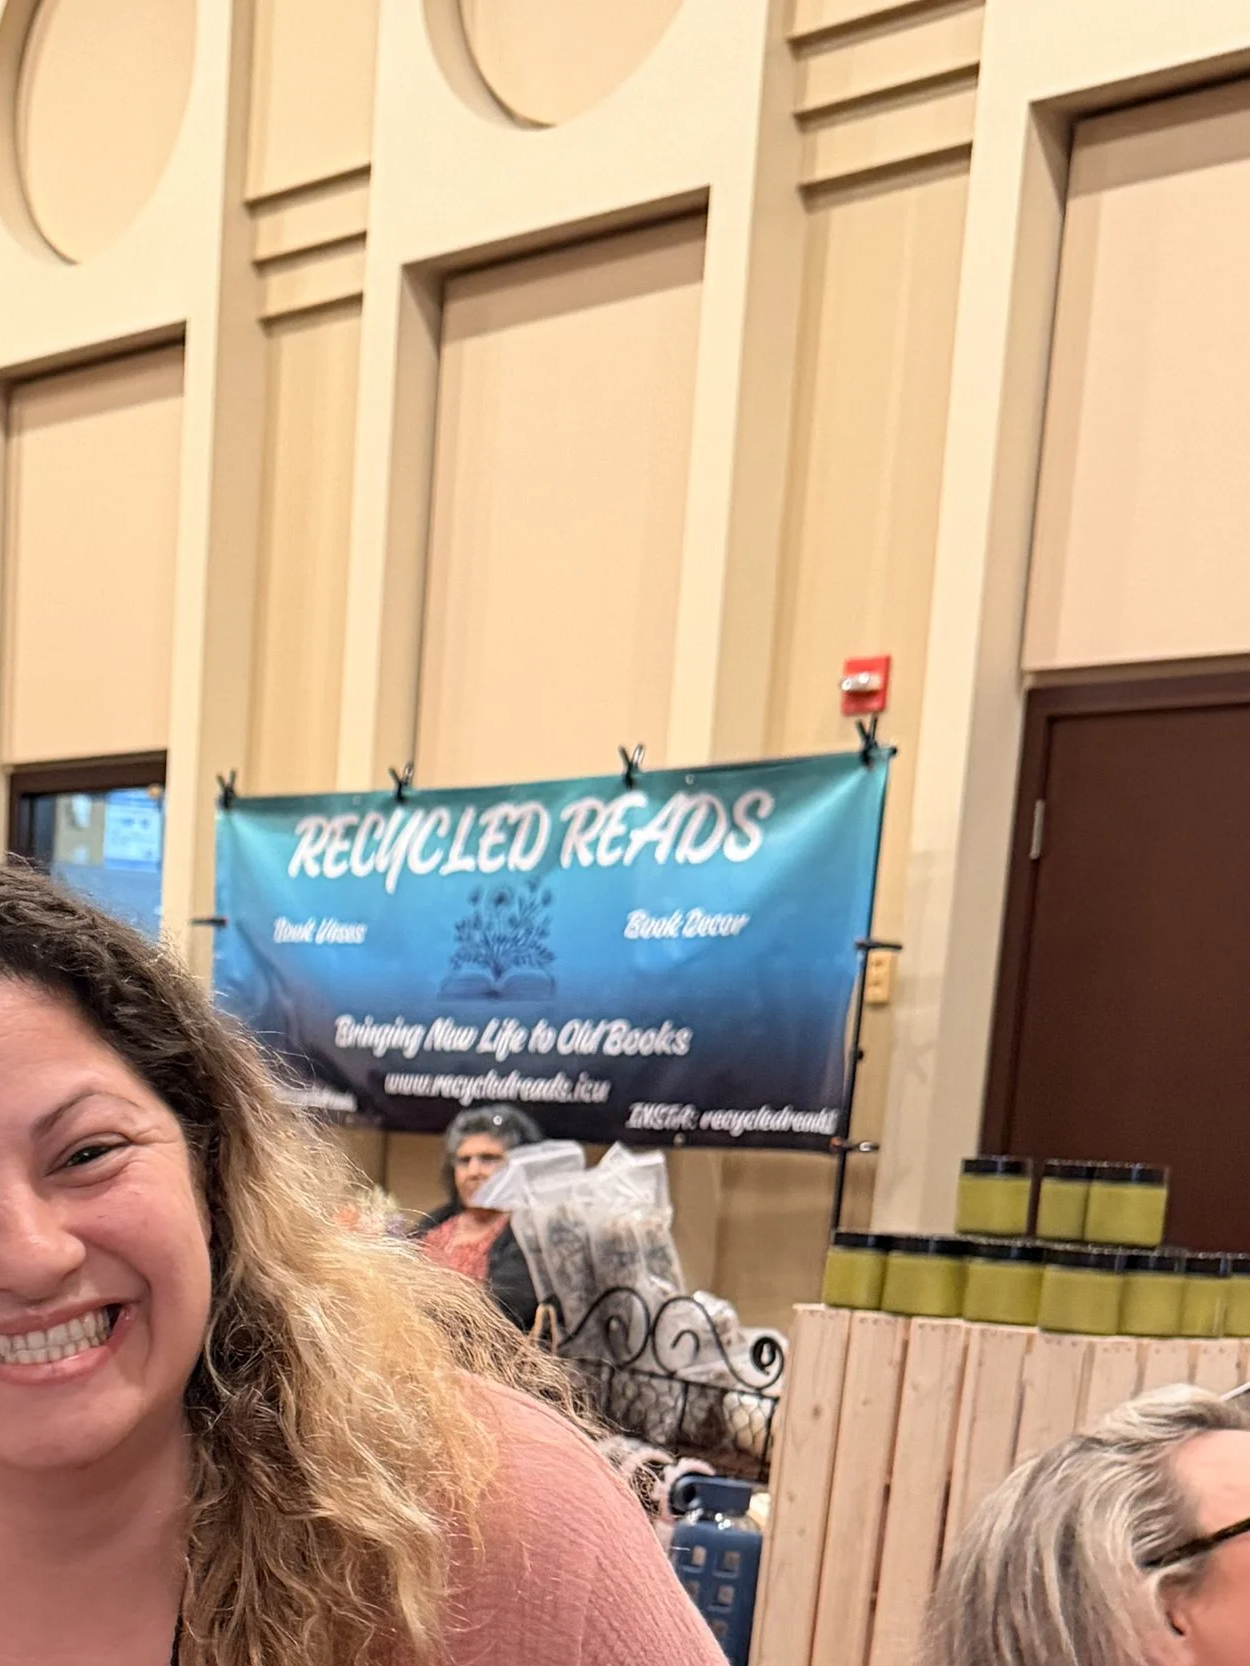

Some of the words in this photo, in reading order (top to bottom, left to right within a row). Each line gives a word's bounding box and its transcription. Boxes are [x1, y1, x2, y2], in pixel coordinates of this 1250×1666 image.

[288, 800, 550, 895] RECYCLED
[559, 789, 775, 870] READS
[623, 907, 683, 940] Book
[334, 1013, 426, 1060] Bringing
[423, 1015, 479, 1052] New
[477, 1016, 530, 1062] Life
[528, 1018, 557, 1054] to
[556, 1017, 607, 1056] Old
[602, 1018, 694, 1057] Books
